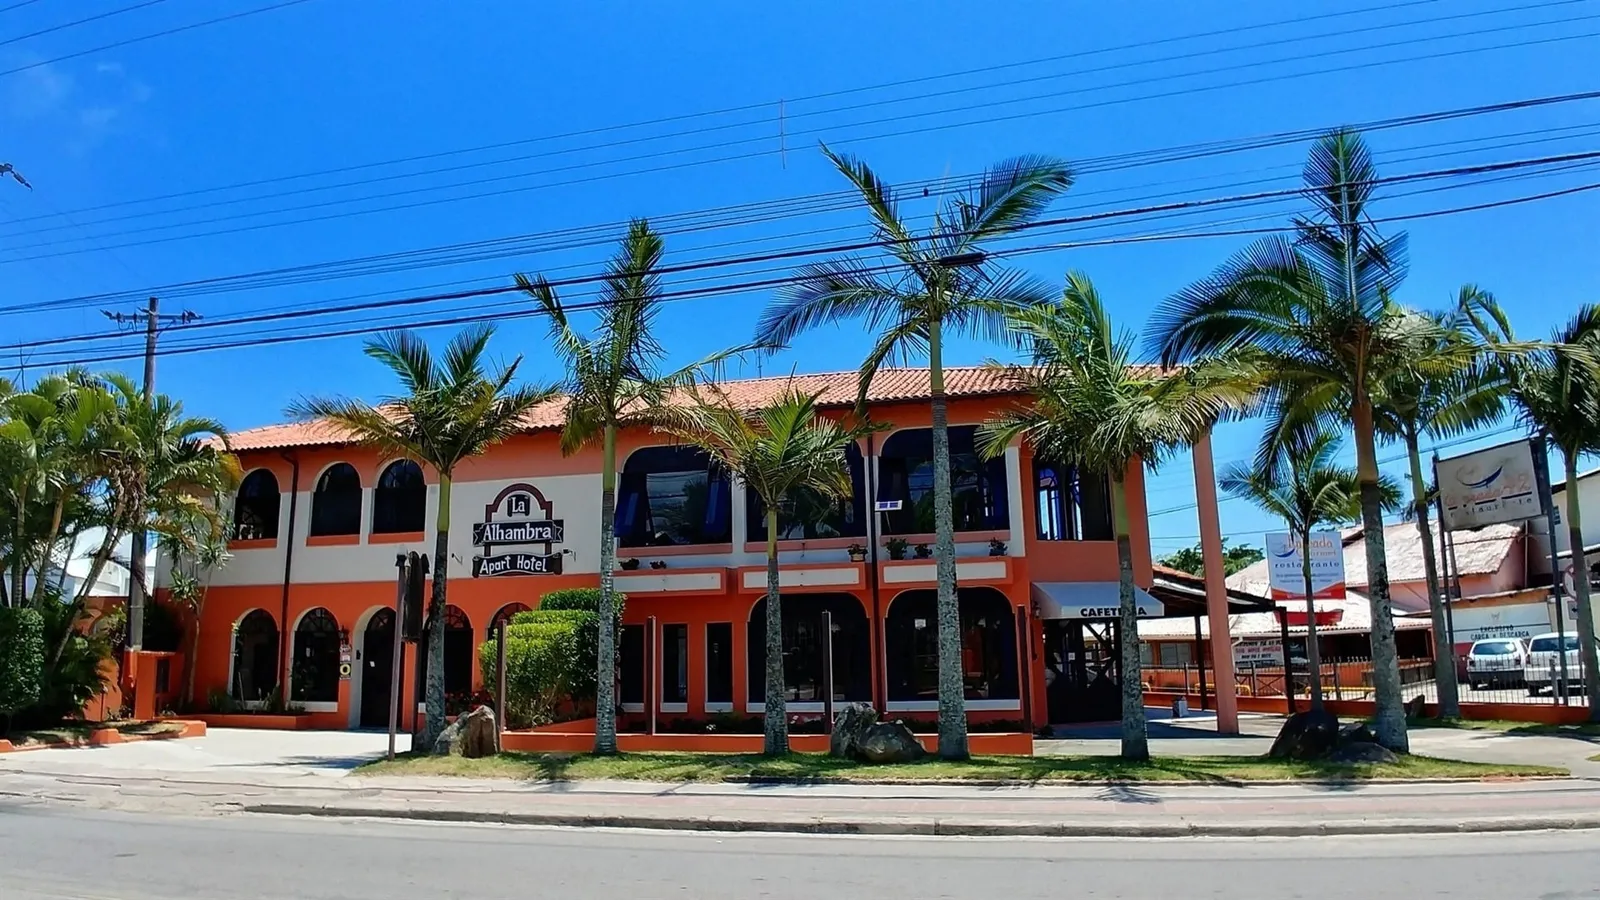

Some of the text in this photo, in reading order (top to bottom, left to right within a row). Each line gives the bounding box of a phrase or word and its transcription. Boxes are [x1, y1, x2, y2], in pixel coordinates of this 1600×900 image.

[511, 496, 525, 512] La
[483, 522, 552, 541] Alhambra
[480, 554, 547, 574] Apart Hotel
[1275, 561, 1340, 569] restarante
[1080, 606, 1147, 617] CAFETA
